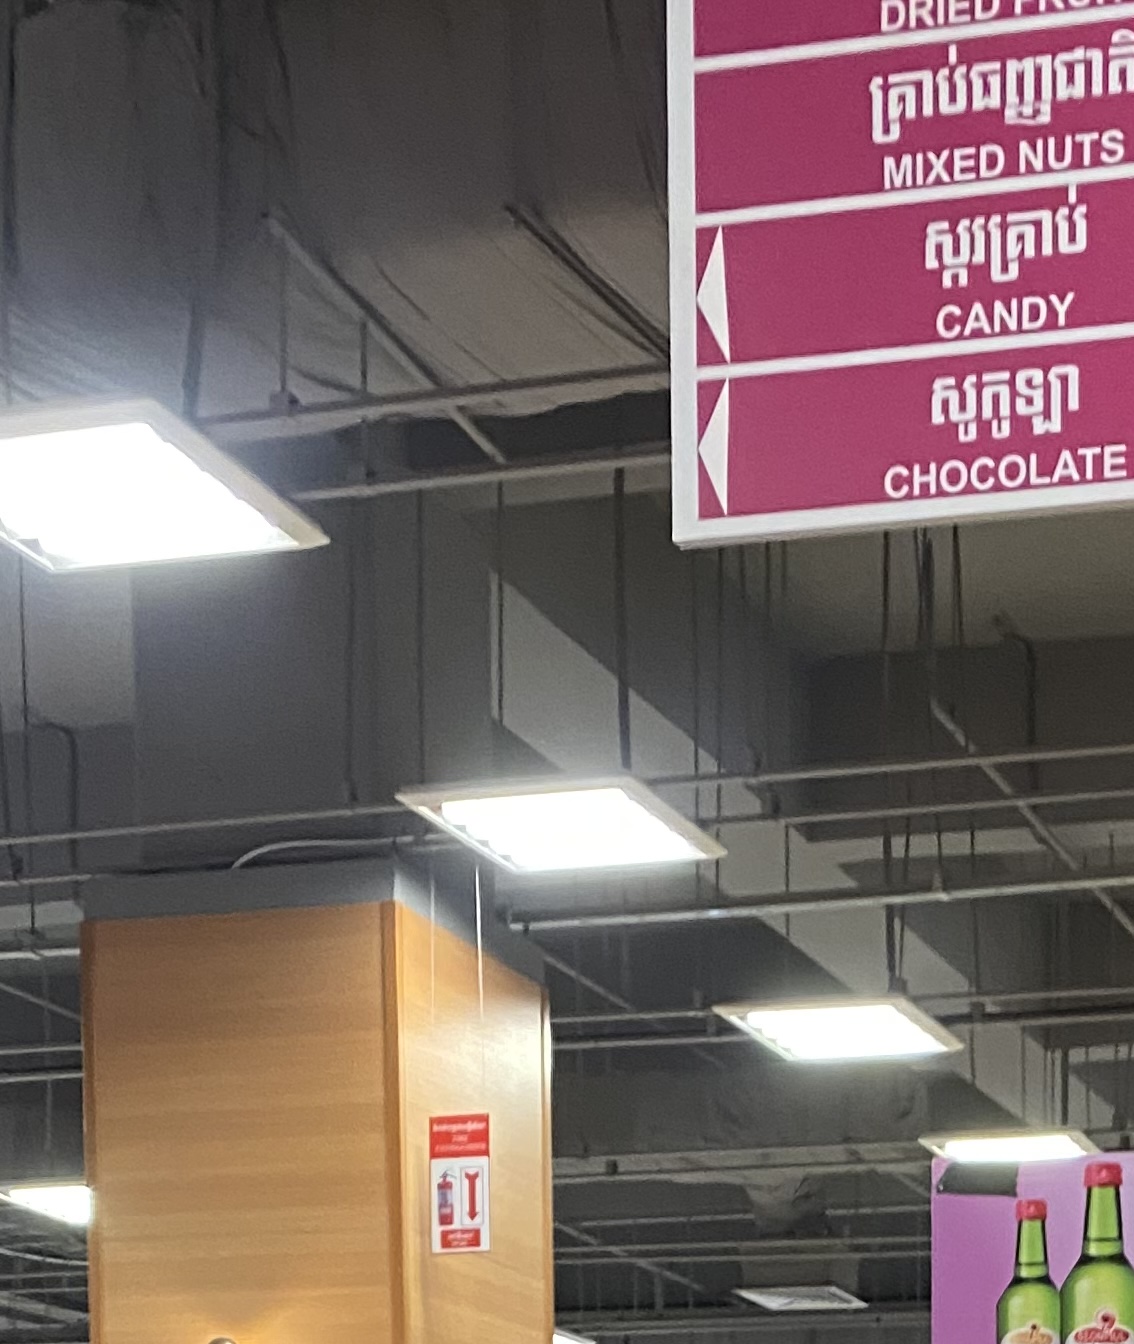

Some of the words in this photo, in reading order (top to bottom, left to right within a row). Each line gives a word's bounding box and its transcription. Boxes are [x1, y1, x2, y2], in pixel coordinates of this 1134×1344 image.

[882, 143, 1003, 191] MIXED
[1020, 129, 1126, 172] NUTS
[935, 292, 1076, 340] CANDY
[883, 444, 1128, 499] CHOCOLATE
